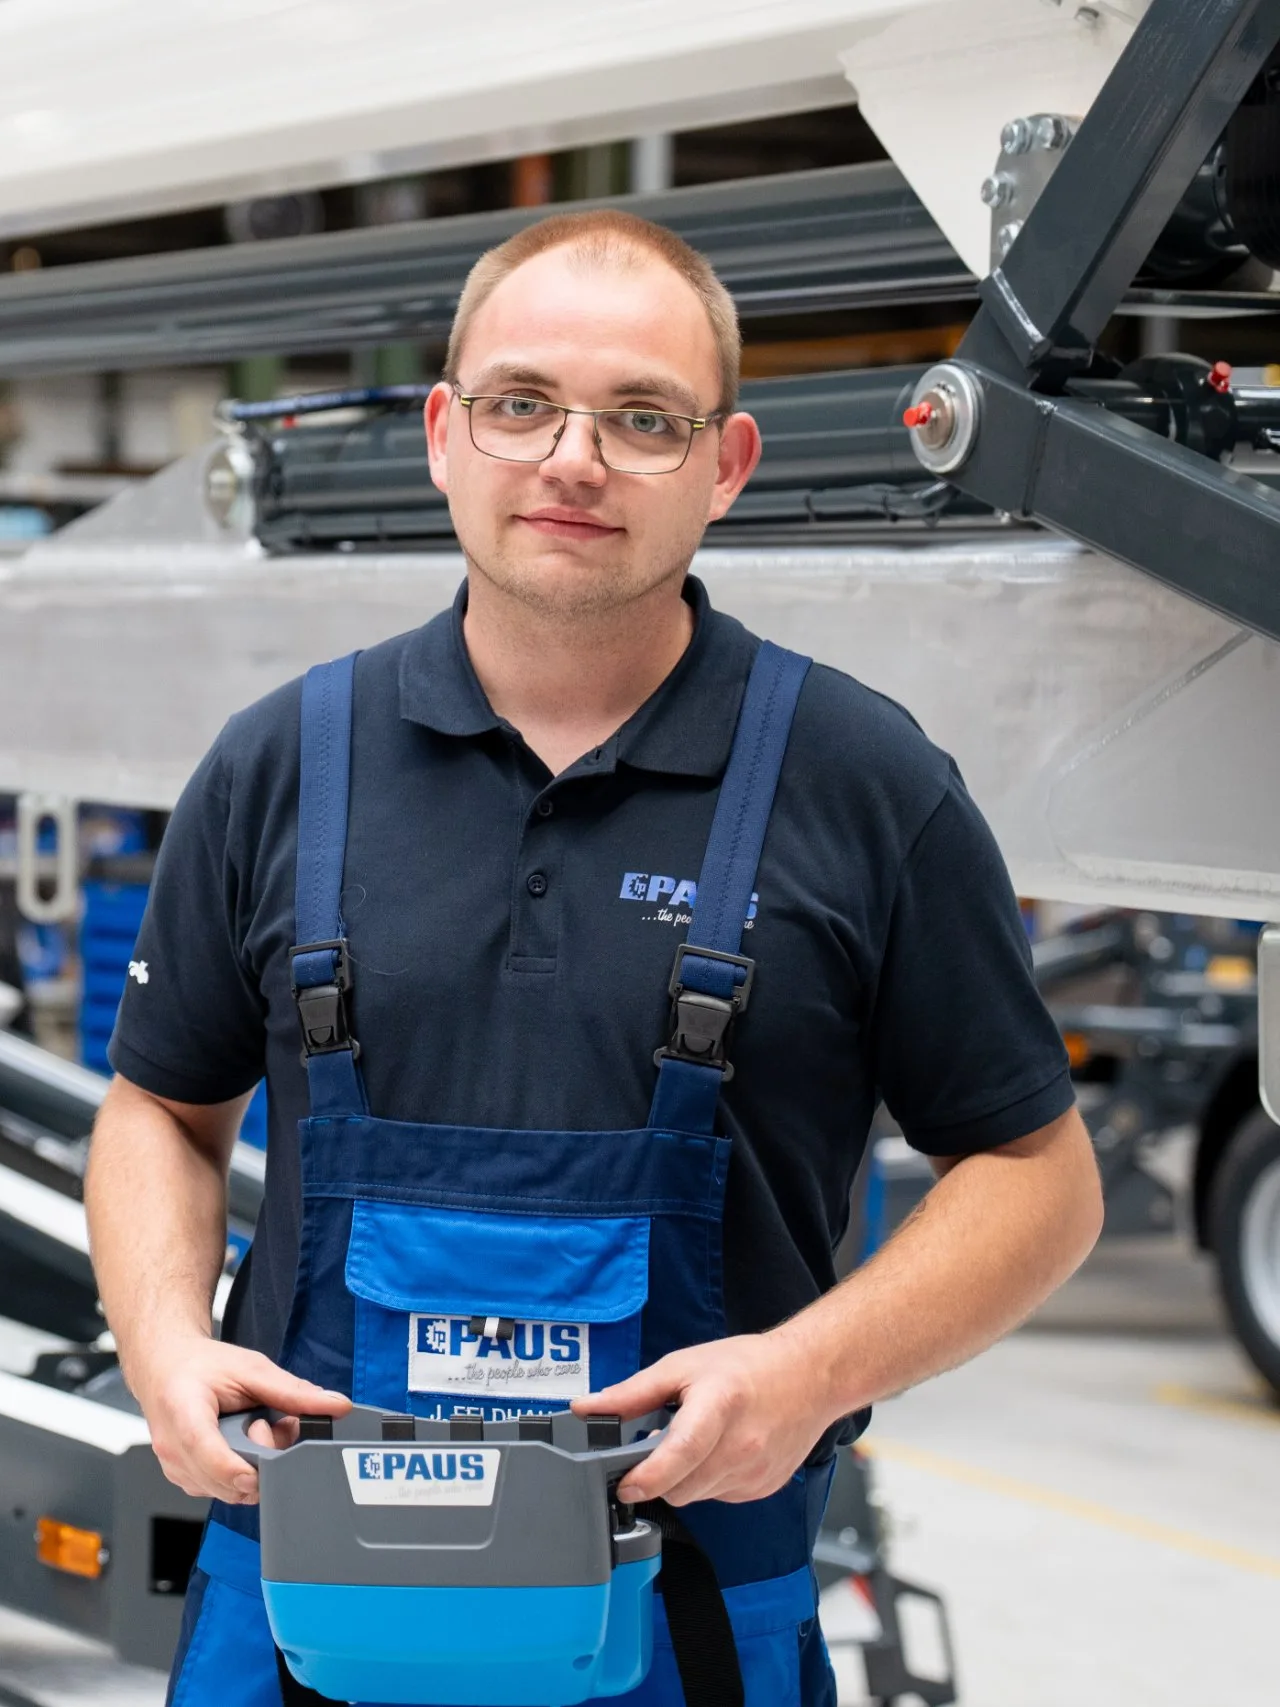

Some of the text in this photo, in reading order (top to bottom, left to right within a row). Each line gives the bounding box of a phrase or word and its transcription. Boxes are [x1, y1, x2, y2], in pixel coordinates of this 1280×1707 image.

[449, 1319, 581, 1362] PAUS
[485, 1359, 525, 1387] people
[526, 1360, 553, 1379] who
[553, 1362, 582, 1376] care
[382, 1453, 485, 1481] PAUS
